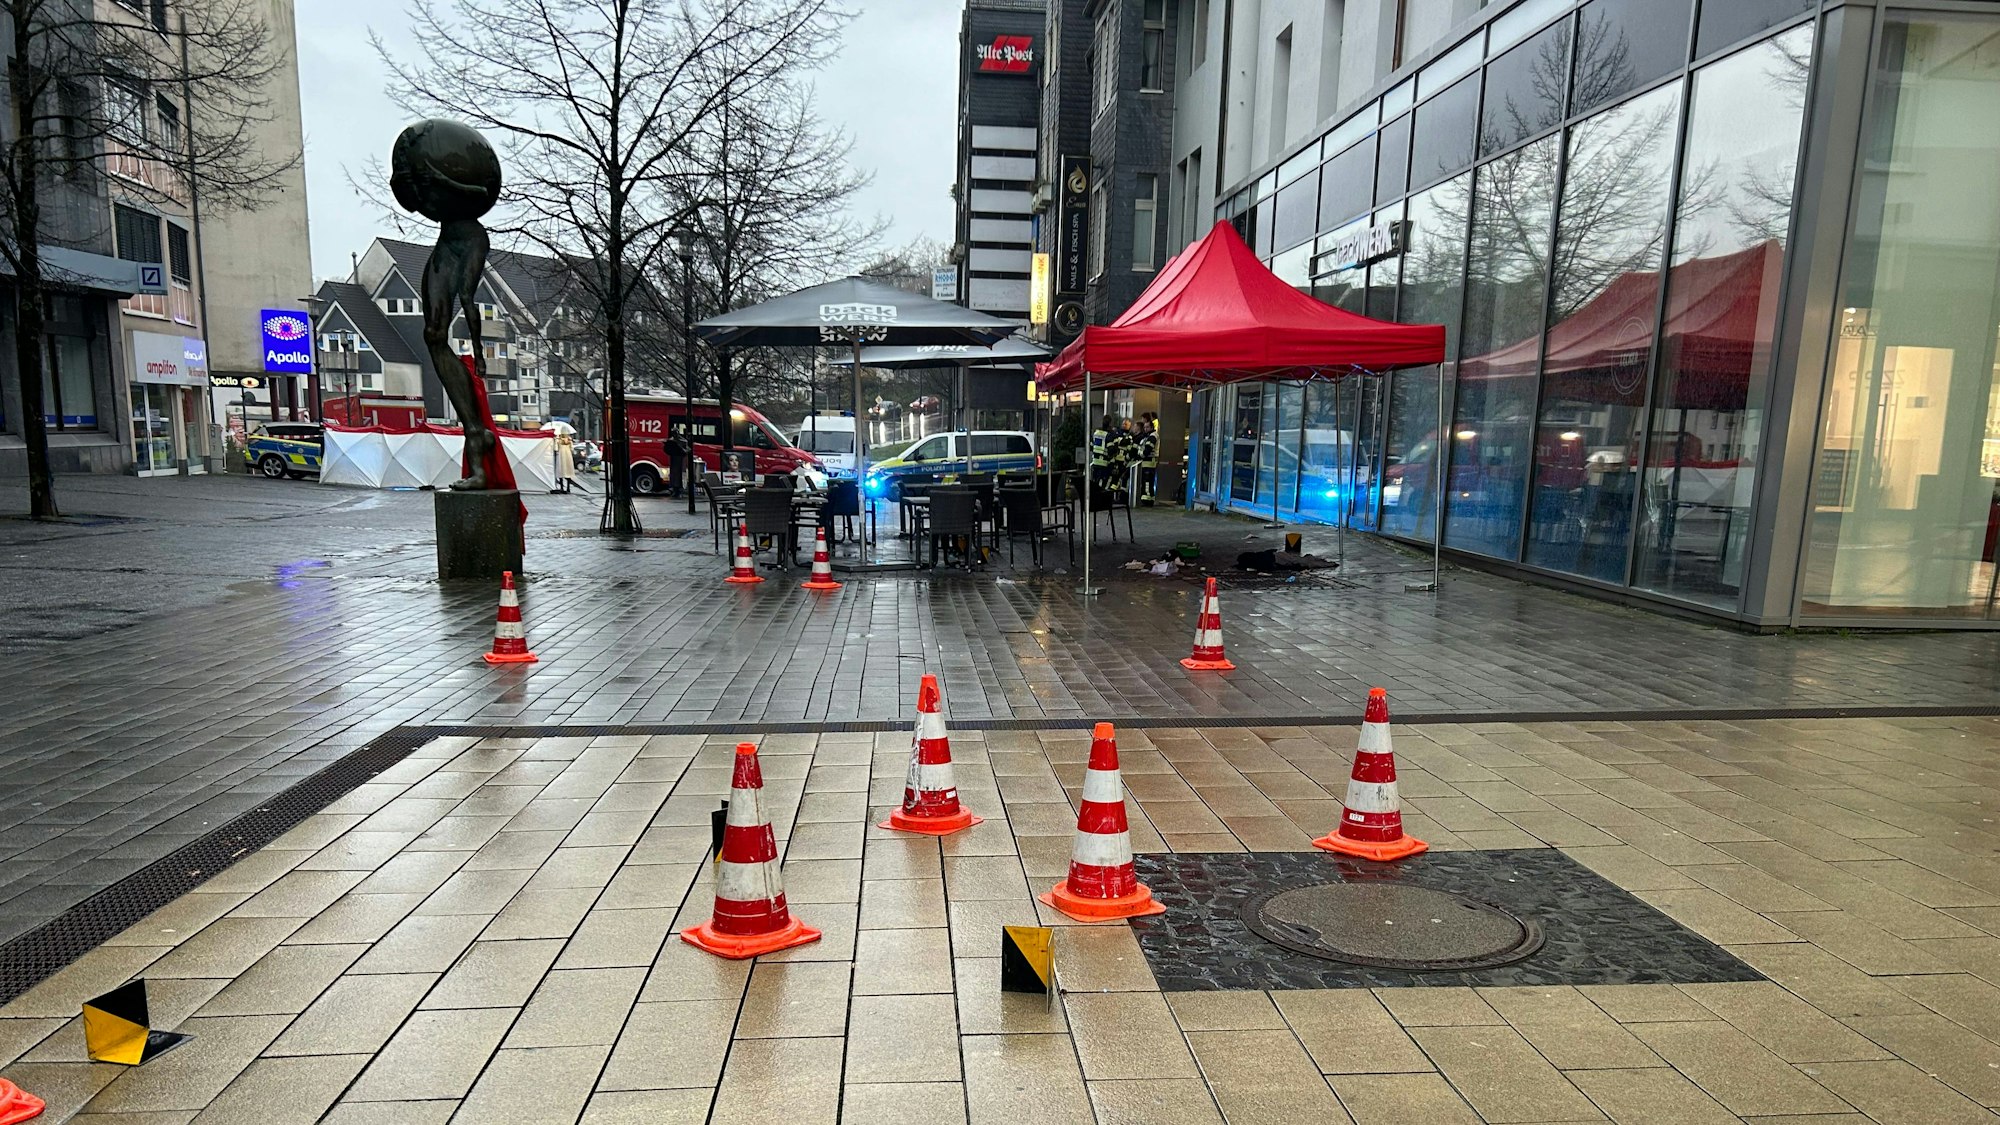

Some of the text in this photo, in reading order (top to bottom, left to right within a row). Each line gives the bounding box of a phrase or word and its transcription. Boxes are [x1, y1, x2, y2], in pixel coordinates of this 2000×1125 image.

[976, 43, 1034, 65] Alte Post
[1071, 229, 1079, 252] FISCH
[1070, 253, 1079, 264] &
[1070, 265, 1078, 289] NAILS
[823, 306, 892, 315] back
[820, 313, 897, 324] WERK
[266, 350, 310, 365] Apollo
[146, 360, 178, 378] amplifon
[640, 419, 662, 433] 112
